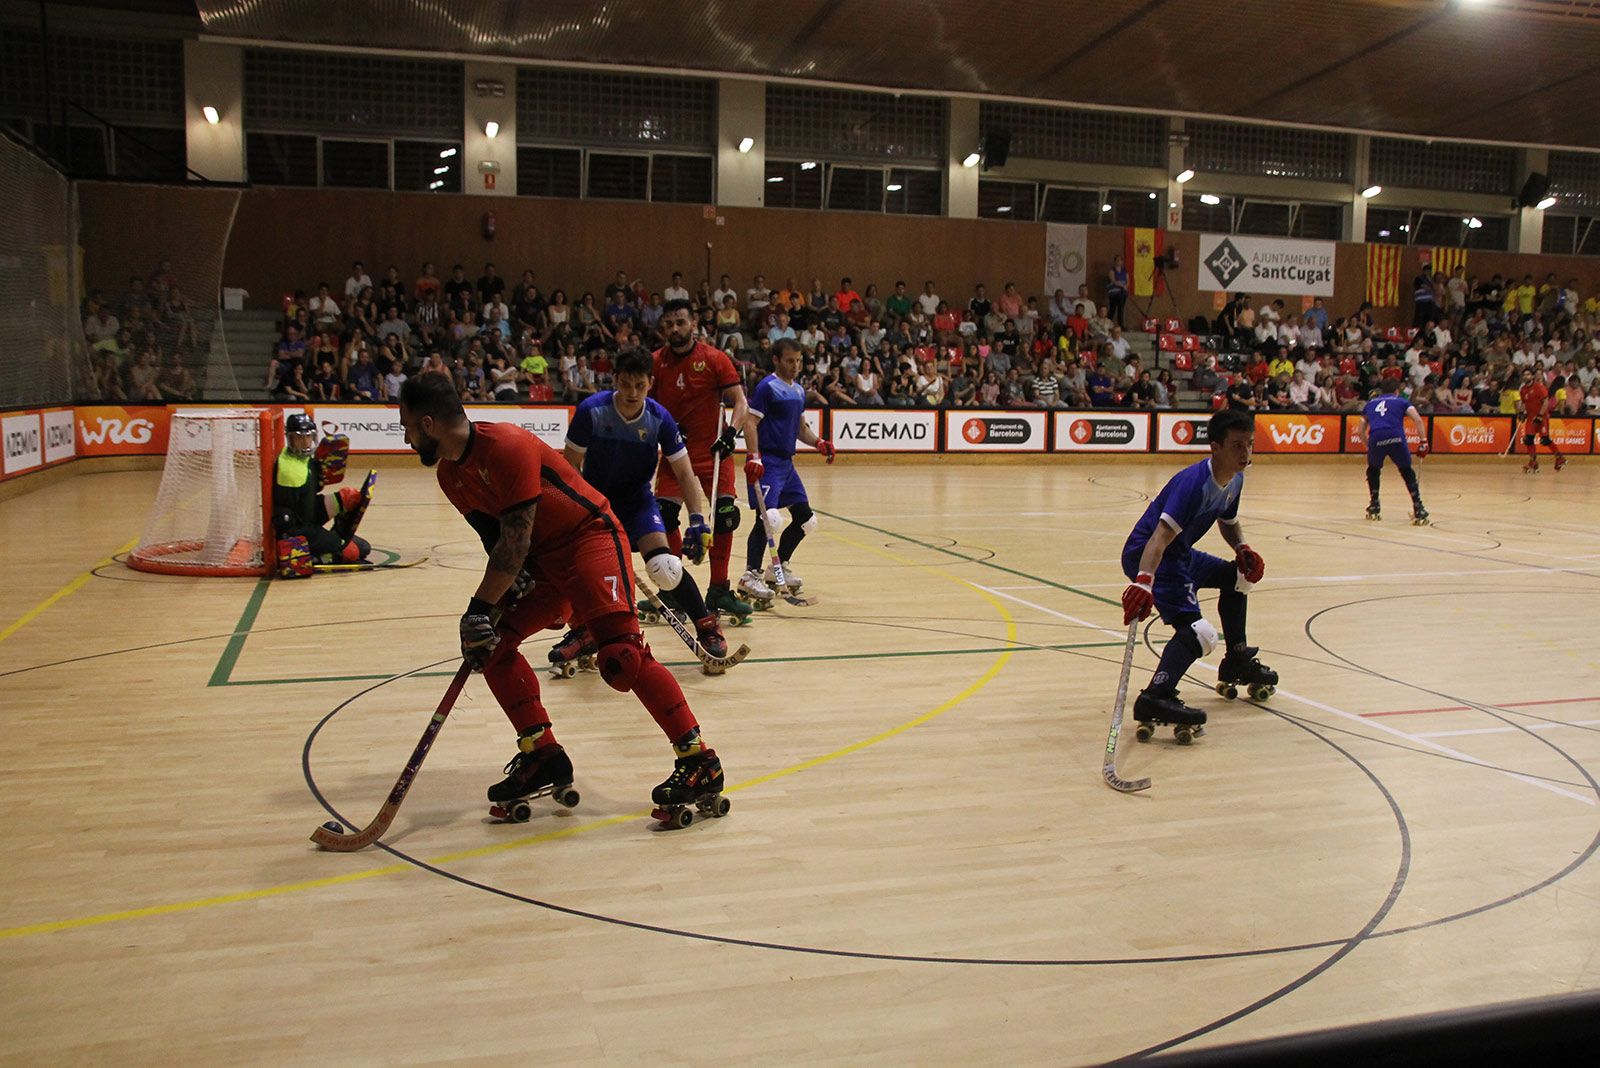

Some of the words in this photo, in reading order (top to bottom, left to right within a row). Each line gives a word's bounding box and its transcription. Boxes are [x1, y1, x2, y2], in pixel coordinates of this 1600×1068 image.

[1253, 252, 1317, 266] AJUNTAMENT
[1319, 256, 1331, 267] DE
[1252, 264, 1331, 284] SantCugat
[676, 372, 686, 390] 4
[1374, 400, 1388, 417] 4
[79, 416, 155, 446] WRG
[839, 422, 926, 440] AZEMAD
[989, 430, 1024, 438] Barcelona
[1095, 431, 1128, 439] Barcelona
[1269, 422, 1325, 445] WRG
[1466, 434, 1495, 444] SKATE
[1467, 426, 1495, 435] WORLD
[761, 485, 771, 501] 7
[603, 575, 619, 602] 7
[1183, 582, 1197, 606] 3
